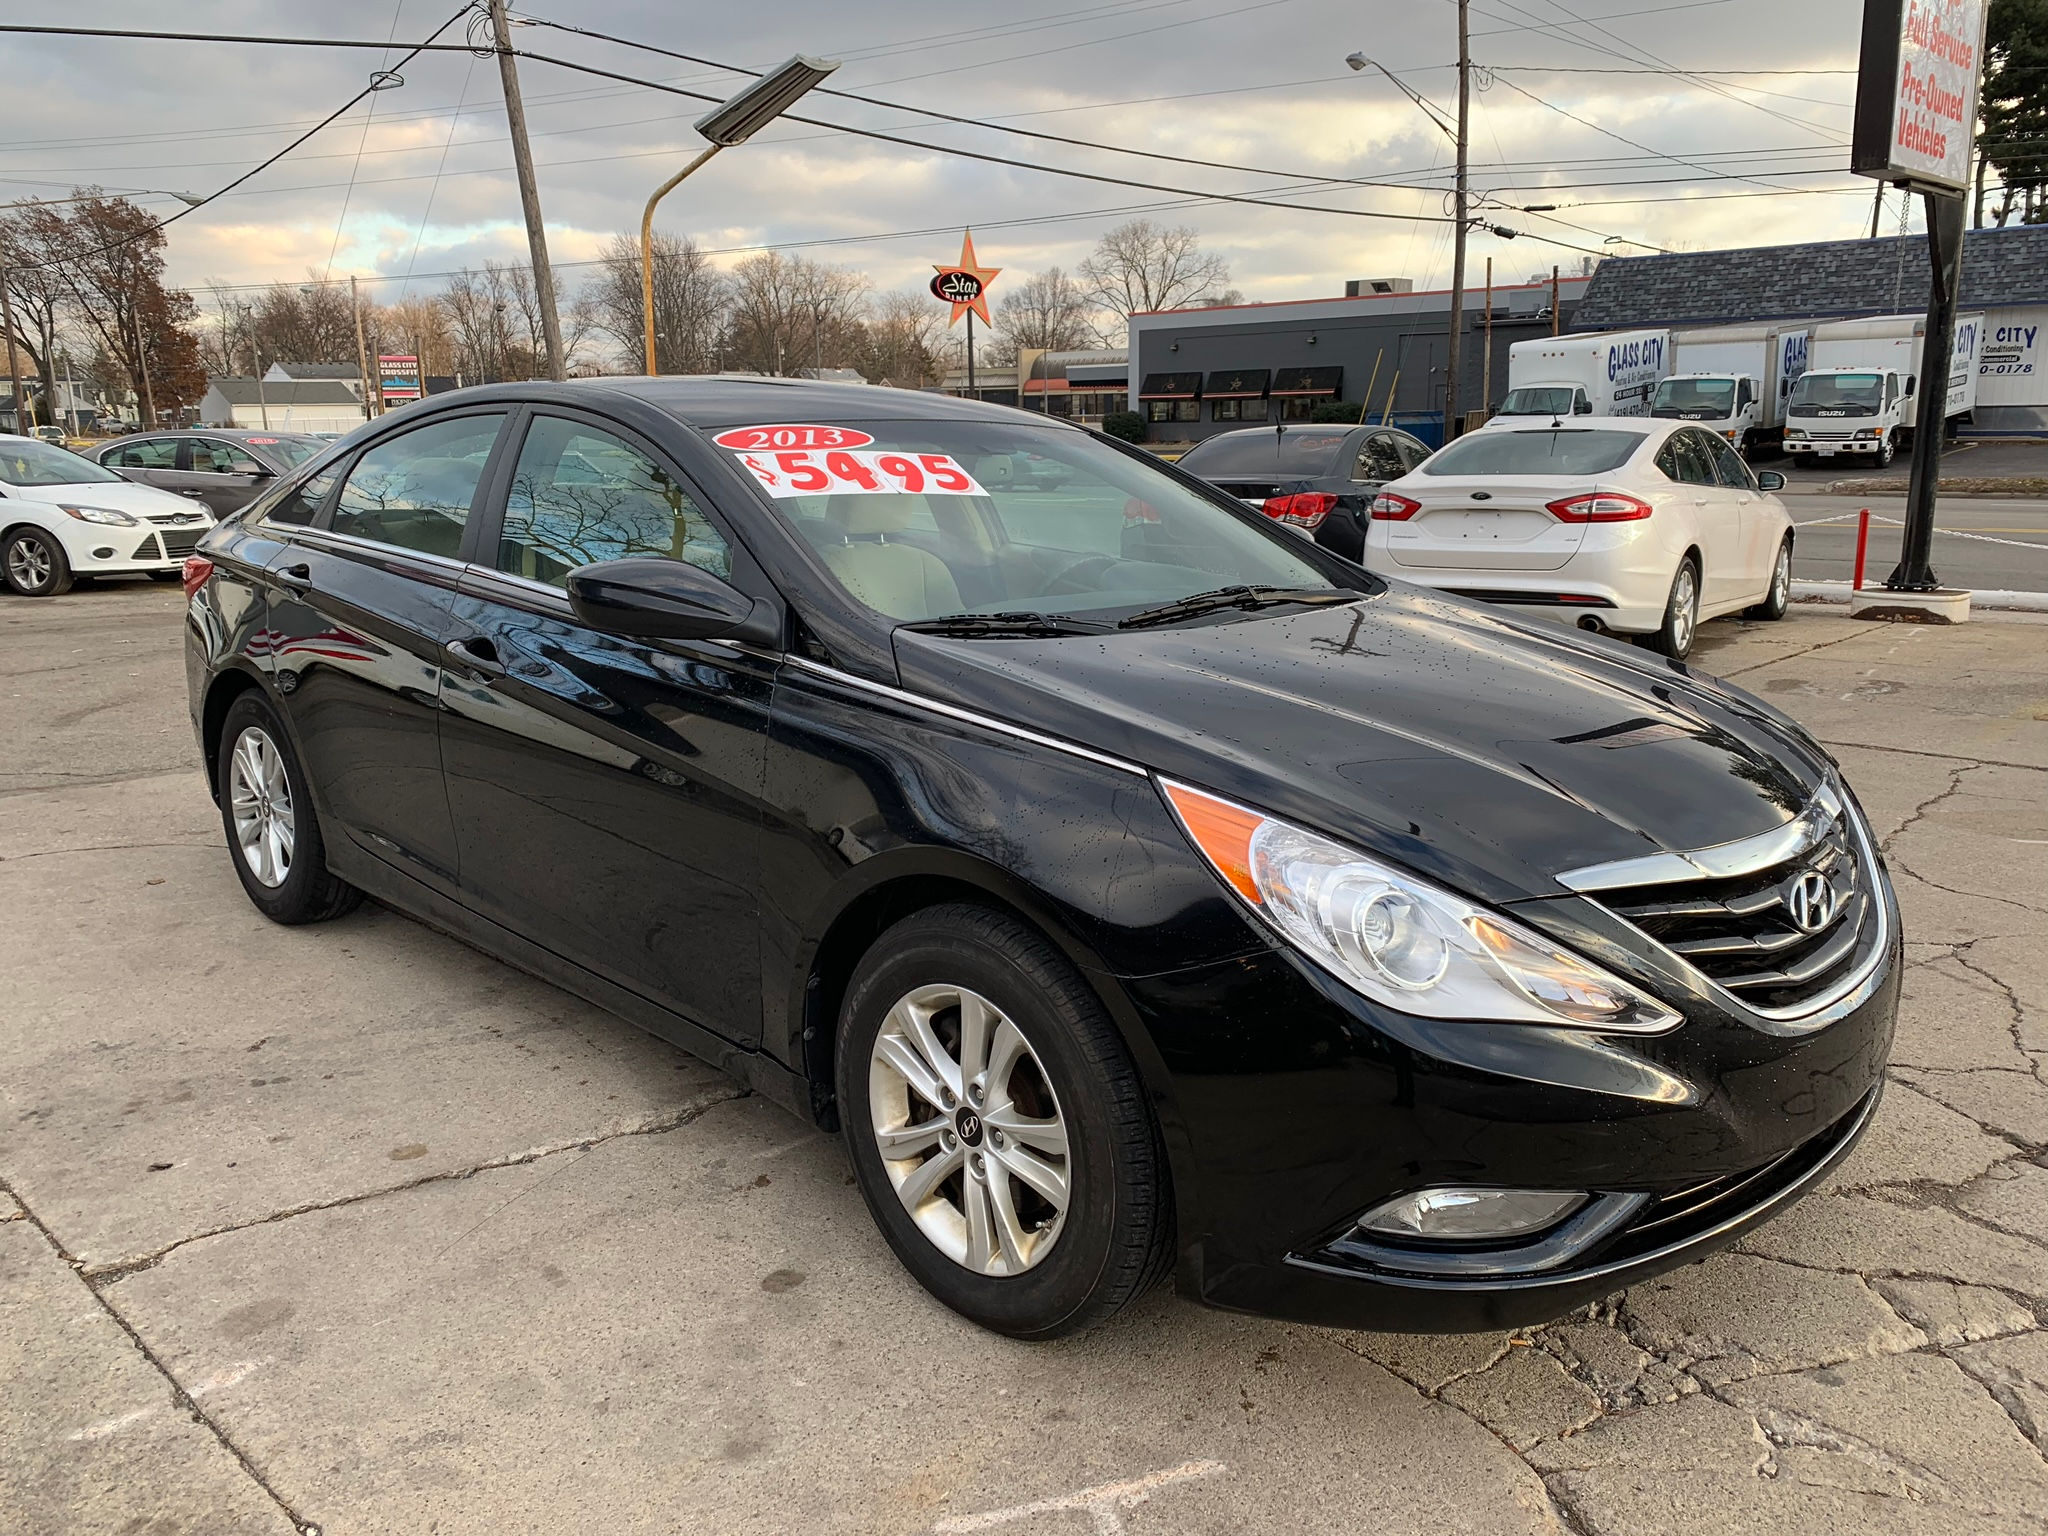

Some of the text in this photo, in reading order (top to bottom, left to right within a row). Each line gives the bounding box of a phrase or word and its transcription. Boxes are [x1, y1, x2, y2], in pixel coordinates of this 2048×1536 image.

[1906, 2, 1973, 70] Full Service
[1901, 61, 1965, 123] Pre-Owned
[1898, 108, 1946, 160] Vehicles
[942, 272, 978, 293] Star
[945, 291, 975, 302] DINER
[1957, 322, 1978, 360] CITY
[1985, 345, 2024, 353] Conditioning
[1996, 326, 2037, 348] CITY
[1608, 336, 1664, 382] GLASS CITY
[747, 428, 845, 449] 2013
